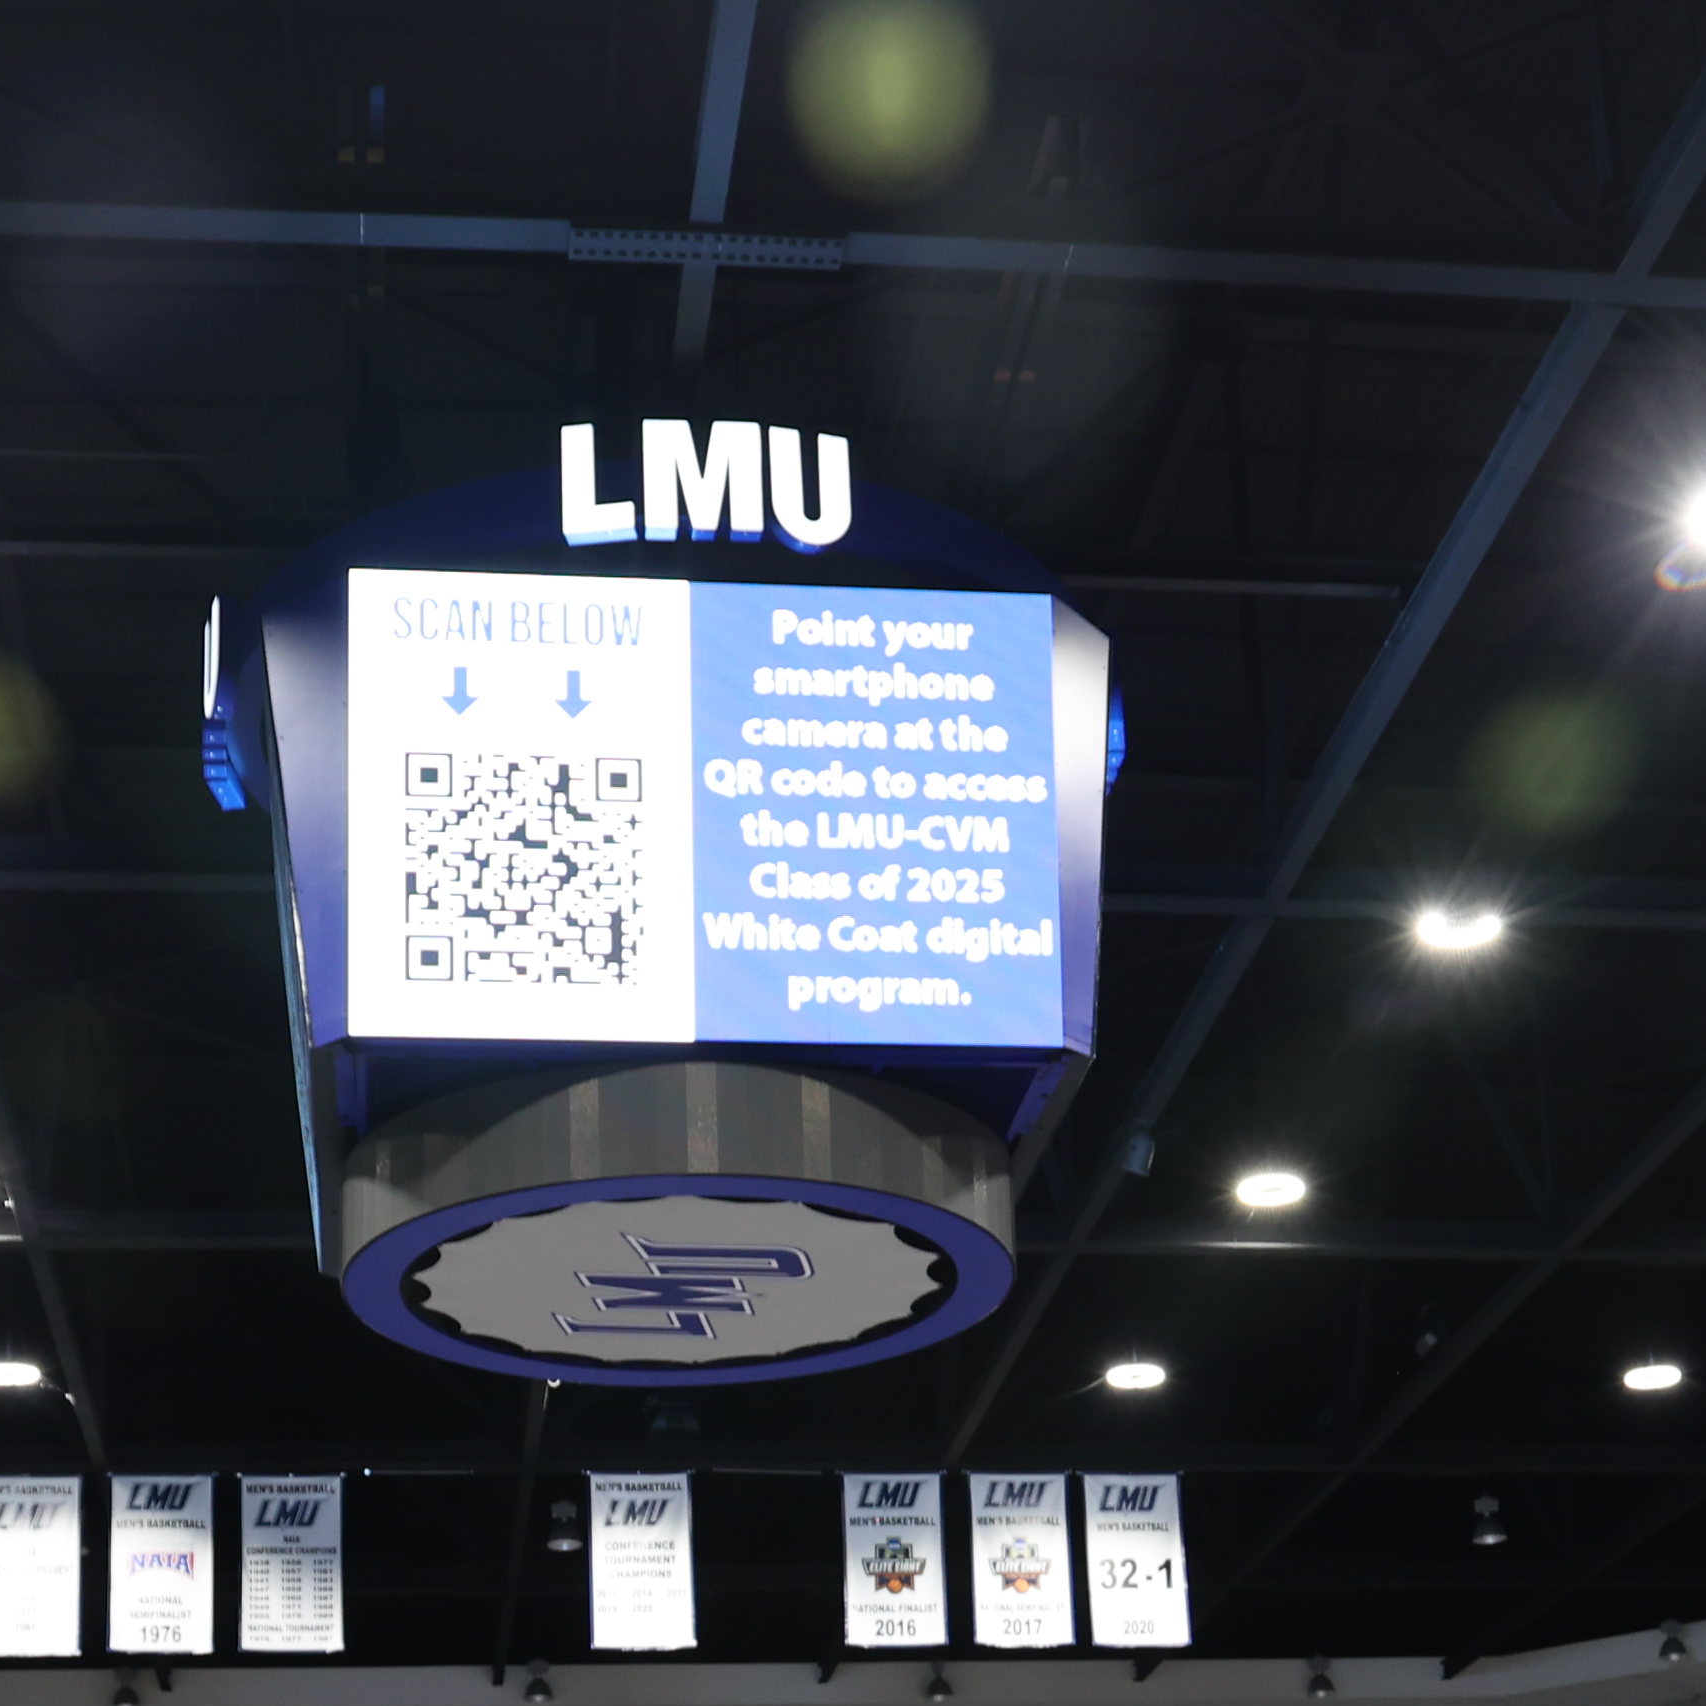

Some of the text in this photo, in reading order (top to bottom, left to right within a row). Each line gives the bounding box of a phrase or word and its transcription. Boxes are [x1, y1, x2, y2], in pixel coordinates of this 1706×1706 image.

[560, 418, 852, 548] LMU
[393, 597, 642, 646] SCAN BELOW
[772, 608, 974, 657] Point your
[753, 661, 995, 707] smartphone
[741, 714, 1009, 753] camera at the
[703, 758, 1048, 803] QR code to access
[739, 808, 1010, 853] the LMU-CVM
[749, 861, 1006, 904] Class of 2025
[702, 911, 1054, 963] White Coat digital
[788, 974, 972, 1013] program.
[552, 1231, 815, 1341] LMU
[127, 1482, 201, 1511] LMU
[246, 1483, 336, 1494] MEN'S BASKETBALL
[625, 1482, 682, 1492] BASKETBALL
[858, 1480, 930, 1509] LMU
[983, 1480, 1054, 1509] LMU
[1098, 1484, 1168, 1513] LMU
[146, 1519, 206, 1529] BASKETBALL
[254, 1498, 329, 1529] LMU
[604, 1497, 675, 1527] LMU
[849, 1516, 936, 1526] MEN'S BASKETBALL
[1122, 1521, 1170, 1532] BASKETBALL
[129, 1552, 193, 1577] NAIA
[605, 1555, 676, 1565] TOURNAMENT
[139, 1625, 182, 1643] 1976
[875, 1619, 917, 1636] 2016
[1003, 1618, 1043, 1636] 2017
[1123, 1620, 1155, 1635] 2020
